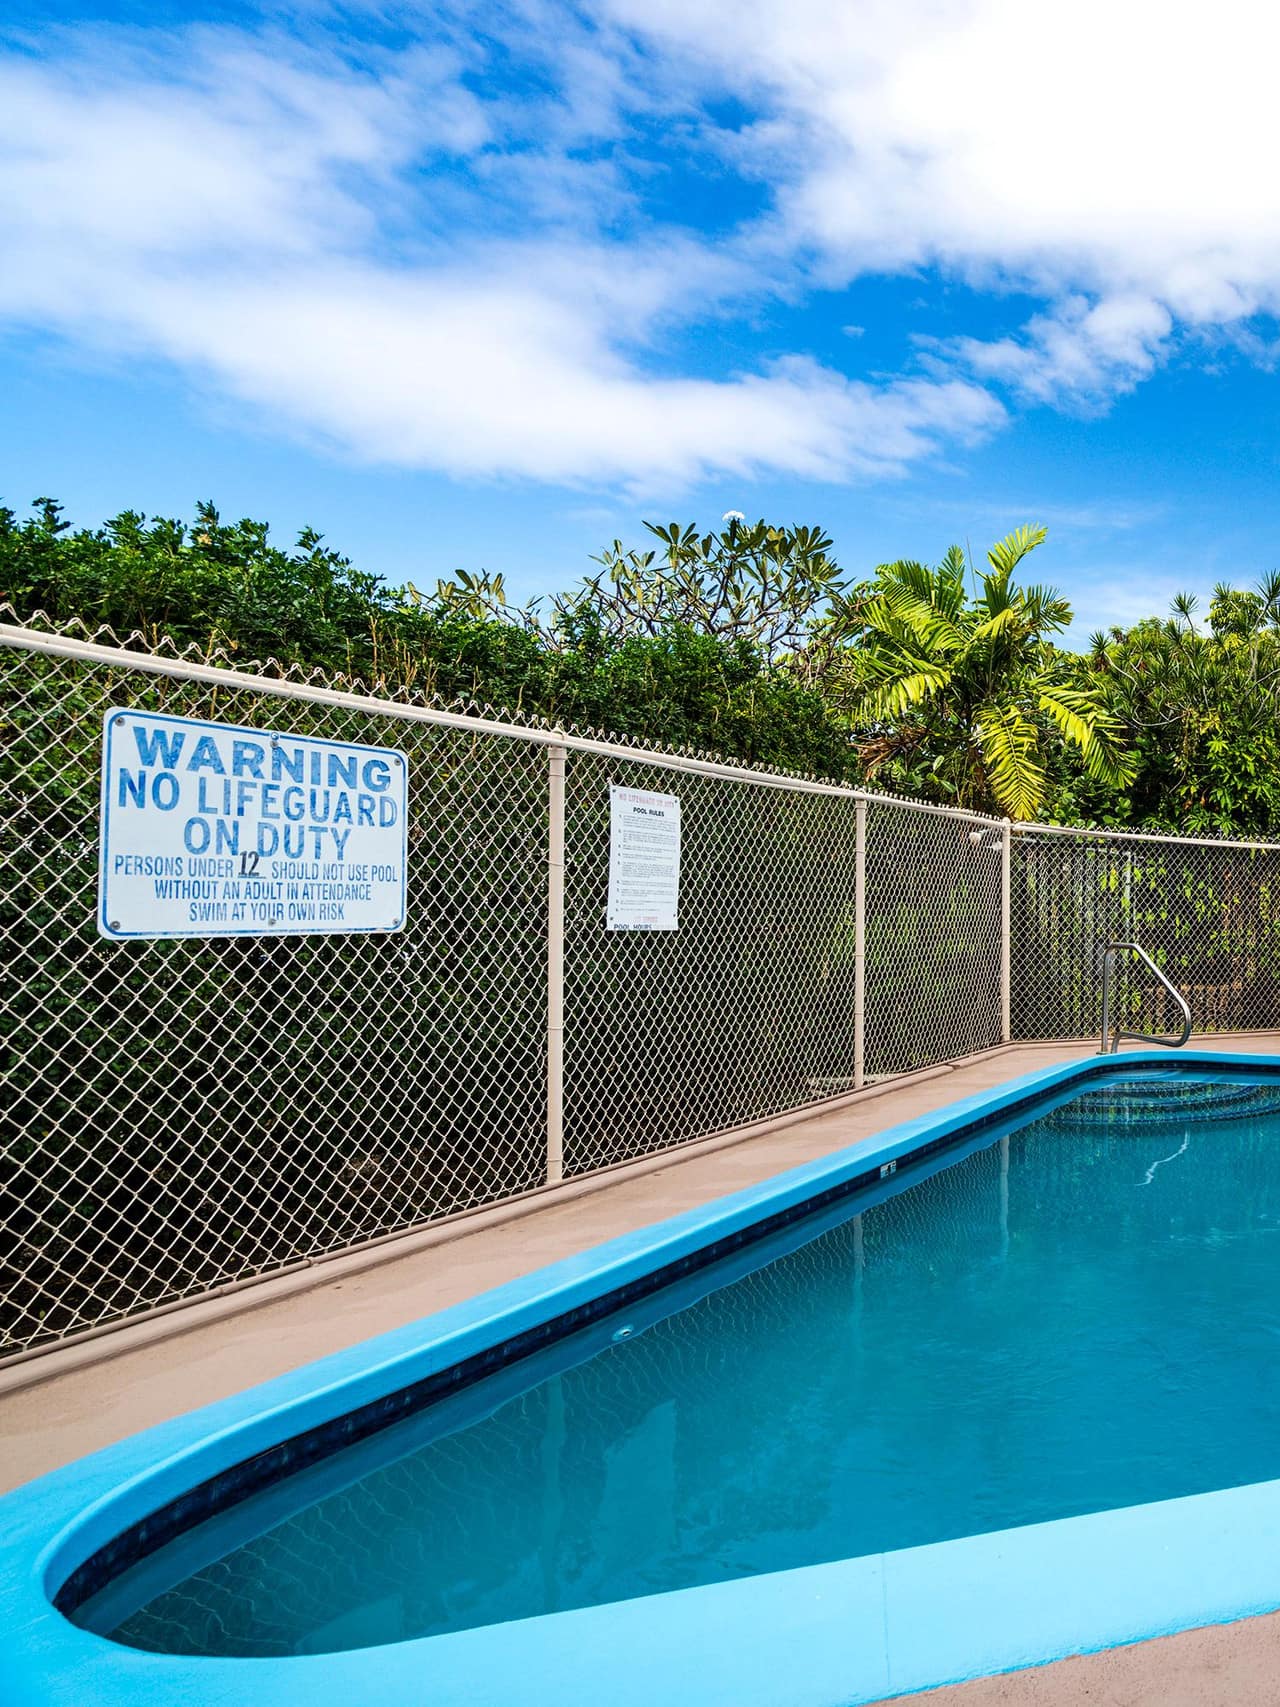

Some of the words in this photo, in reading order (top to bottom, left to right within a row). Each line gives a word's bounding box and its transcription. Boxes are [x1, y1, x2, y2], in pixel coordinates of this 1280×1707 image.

[133, 726, 391, 792] WARNING
[119, 768, 180, 811] NO
[198, 776, 398, 828] LIFEGUARD
[184, 816, 239, 856] ON
[257, 821, 351, 861] DUTY
[115, 855, 183, 877] PERSONS
[189, 859, 233, 878] UNDER
[238, 851, 260, 877] 12
[272, 861, 318, 880] SHOULD
[323, 863, 345, 881] NOT
[348, 864, 368, 881] USE
[371, 864, 398, 882] POOL
[155, 879, 218, 899] WITHOUT
[223, 881, 239, 899] AN
[245, 881, 282, 900] ADULT
[287, 883, 299, 899] IN
[302, 883, 371, 900] ATTENDANCE
[189, 903, 227, 921] SWIM
[232, 903, 247, 920] AT
[251, 903, 284, 920] YOUR
[288, 903, 315, 920] OWN
[320, 903, 344, 920] RISK
